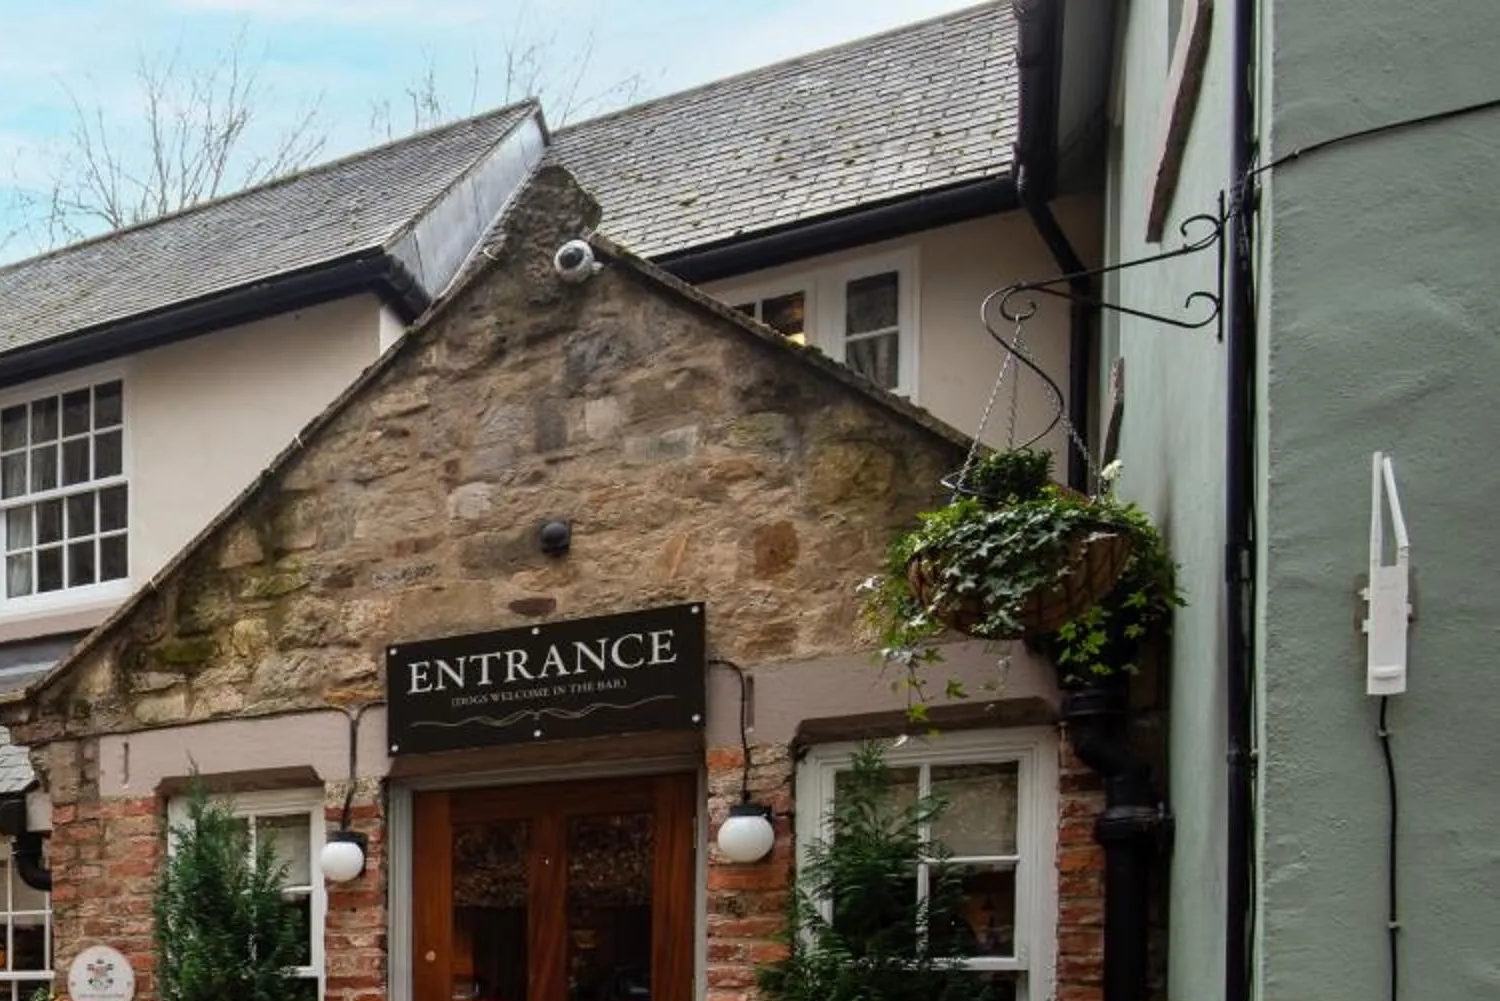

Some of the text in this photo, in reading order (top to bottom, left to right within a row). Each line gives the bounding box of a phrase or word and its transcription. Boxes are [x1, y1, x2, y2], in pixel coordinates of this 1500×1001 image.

[407, 629, 678, 695] ENTRANCE
[490, 686, 549, 702] WELCOME
[553, 686, 566, 697] IN
[570, 681, 594, 694] THE
